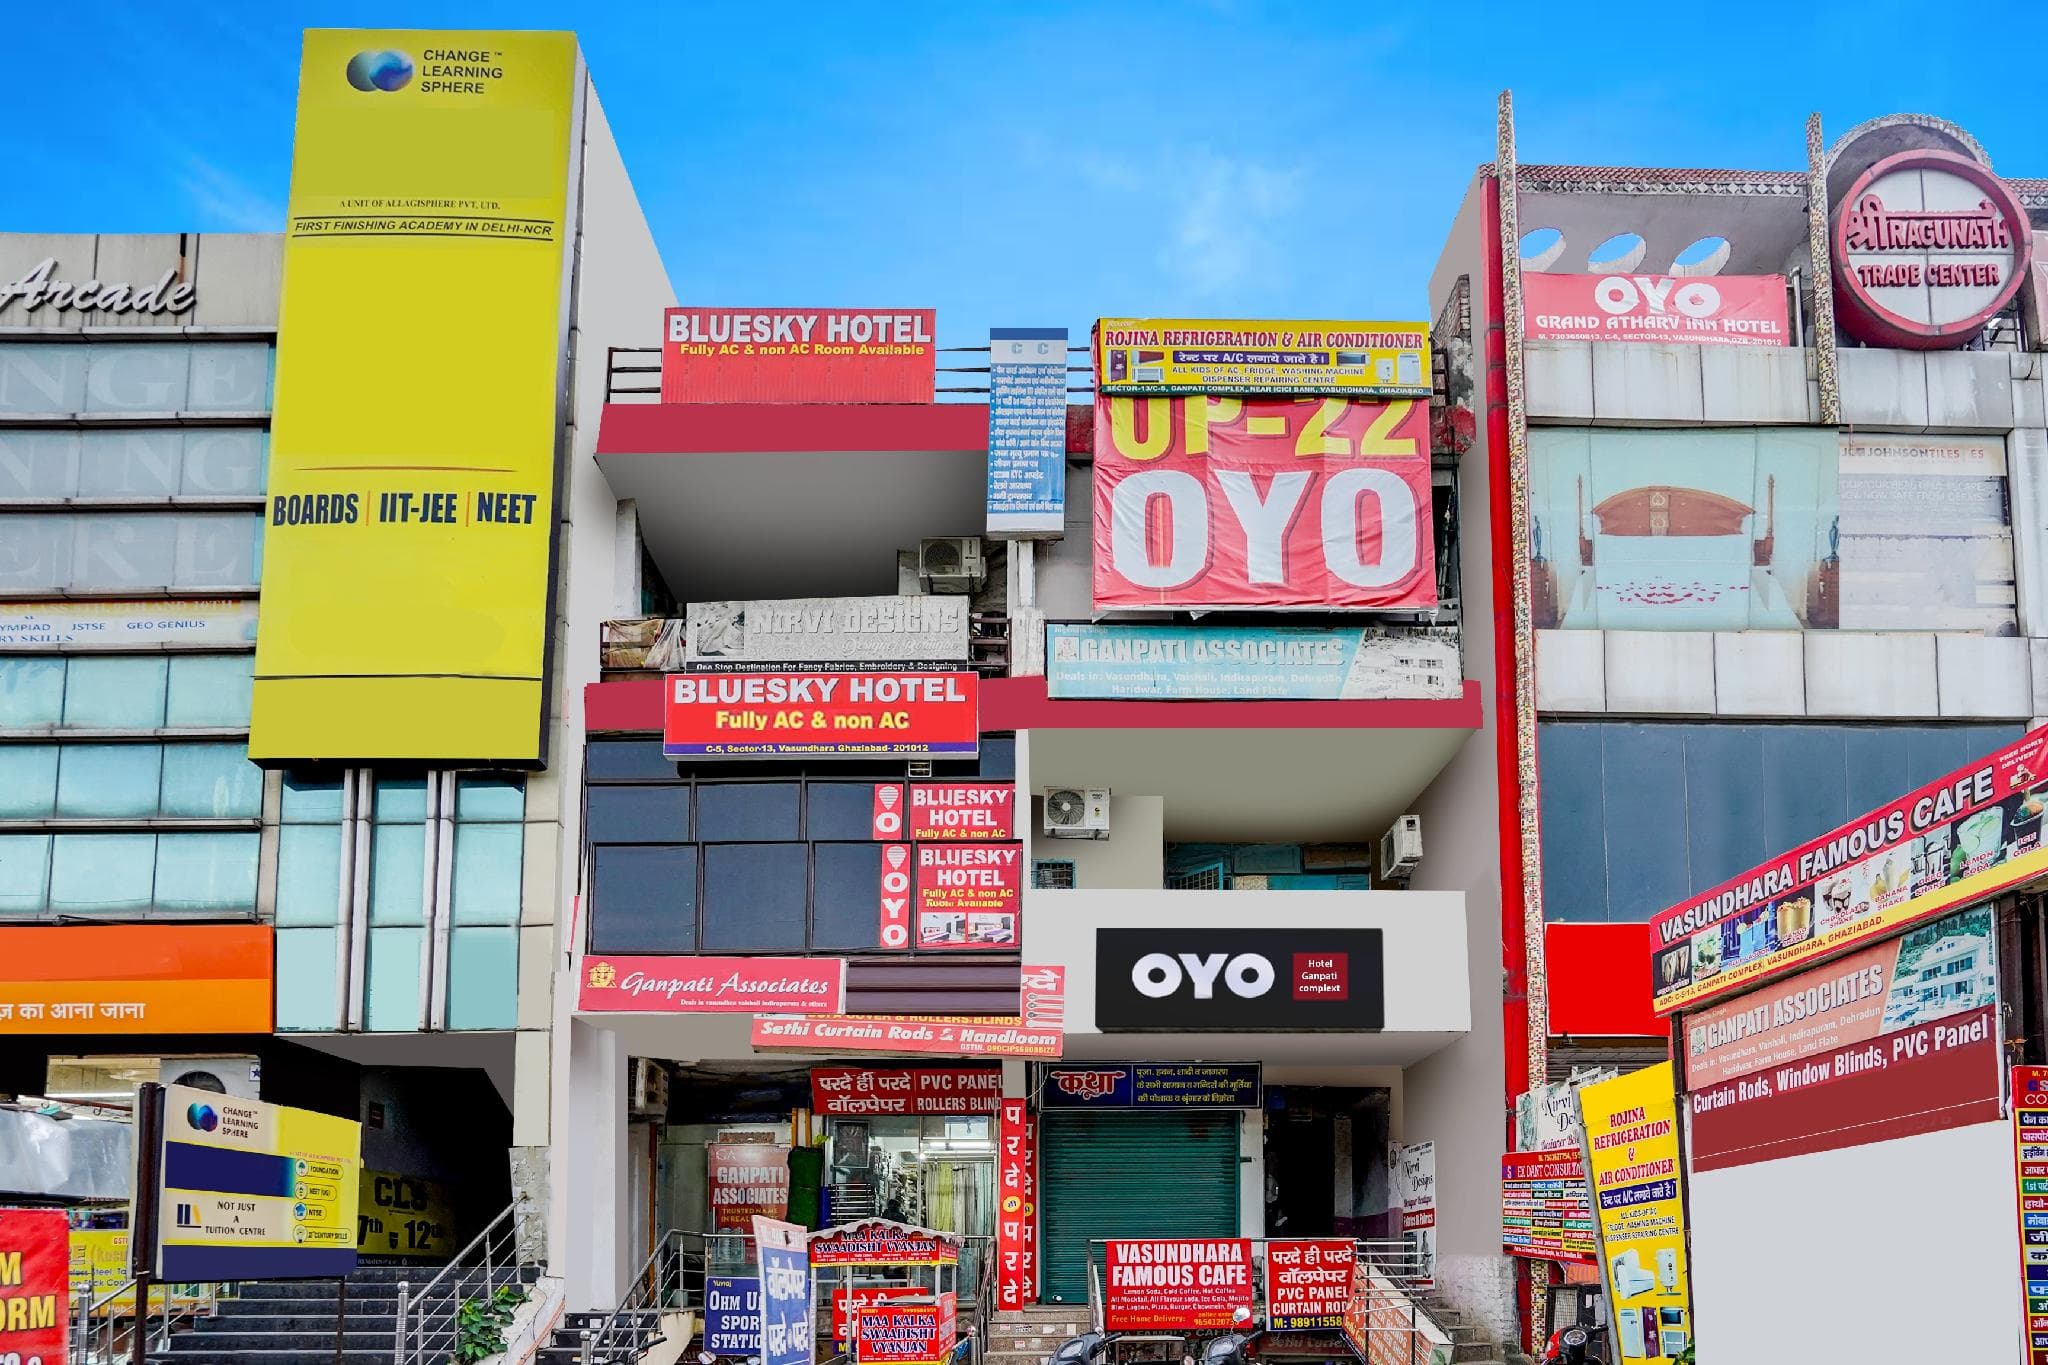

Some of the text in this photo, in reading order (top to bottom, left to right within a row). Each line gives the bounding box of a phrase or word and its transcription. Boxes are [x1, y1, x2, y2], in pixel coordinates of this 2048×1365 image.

[423, 49, 490, 63] CHANGE
[422, 66, 503, 79] LEARNING
[421, 82, 485, 94] SPHERE
[347, 200, 369, 208] UNIT
[371, 200, 384, 208] OF
[295, 220, 552, 235] FIRST FINISHING ACADEMY IN DELHI-NCR
[1890, 217, 2009, 250] RAGUNATH
[1859, 264, 2000, 287] TRADE CENTER
[0, 257, 196, 315] Arcade
[1595, 276, 1721, 318] OYO
[669, 315, 931, 343] BLUESKY HOTEL
[1536, 315, 1781, 334] GRAND ATHARV INN HOTEL
[1105, 330, 1423, 348] ROJINA REFRIGERATION & AIR CONDITIONER
[680, 344, 924, 356] Fully AC & non AC Room Available
[273, 492, 536, 526] BOARDS IIT-JEE NEET
[1112, 468, 1417, 588] OYO
[127, 621, 153, 630] GEO
[158, 620, 205, 629] GENIUS
[1080, 639, 1344, 666] GANPATI ASSOCIATES
[674, 677, 966, 704] BLUESKY HOTEL
[716, 711, 910, 731] Fully AC & non AC
[913, 789, 1009, 806] BLUESKY
[929, 810, 998, 826] HOTEL
[915, 829, 939, 839] Fully
[942, 829, 956, 838] AC
[959, 829, 967, 838] &
[992, 829, 1006, 838] AC
[920, 849, 1016, 866] BLUESKY
[1660, 765, 1993, 945] VASUNDHARA FAMOUS CAFE
[937, 870, 1005, 886] HOTEL
[923, 889, 947, 899] Fully
[950, 889, 964, 897] AC
[967, 889, 974, 897] &
[999, 889, 1014, 897] AC
[1874, 886, 1908, 903] BANANA
[1877, 895, 1904, 911] SHAKE
[1308, 960, 1333, 968] Hotel
[1131, 953, 1275, 999] OYO
[1301, 972, 1338, 982] Ganpati
[620, 972, 828, 999] Ganpati Associates
[1299, 984, 1341, 993] complext
[19, 1003, 145, 1020] का आना जाना
[1707, 964, 1883, 1050] GANPATI ASSOCIATES
[760, 1022, 1056, 1046] Sethi Curtain Rods & Handloom
[1693, 1012, 1989, 1114] Curtain Rods, Window Blinds, PVC Panel
[818, 1071, 912, 1093] परदे ही परदे
[1051, 1071, 1126, 1100] कथा
[223, 1106, 252, 1118] CHANGE
[827, 1094, 906, 1114] वॉलपेपर
[222, 1117, 259, 1129] LEARNING
[1610, 1106, 1646, 1128] ROJINA
[222, 1127, 249, 1138] SPHERE
[1594, 1120, 1671, 1150] REFRIGERATION
[717, 1167, 784, 1184] GANPATI
[1599, 1159, 1674, 1186] AIR CONDITIONER
[713, 1187, 788, 1205] ASSOCIATES
[217, 1201, 256, 1212] NOT JUST
[205, 1225, 266, 1236] TUITION CENTRE
[842, 1230, 908, 1241] MAA KALKA
[815, 1241, 936, 1252] SWAADISHT VYANJAN
[1116, 1243, 1242, 1263] VASUNDHARA
[1272, 1245, 1354, 1265] परदे ही परदे
[1113, 1264, 1247, 1287] FAMOUS CAFE
[1279, 1266, 1348, 1285] वॉलपेपर
[1277, 1286, 1349, 1301] PVC PANEL
[1272, 1301, 1322, 1315] CURTAIN
[862, 1315, 936, 1327] MAA KALKA
[1112, 1315, 1127, 1323] Free
[1273, 1319, 1287, 1329] M:
[862, 1328, 937, 1340] SWAADISHT
[872, 1341, 927, 1353] VYANJAN
